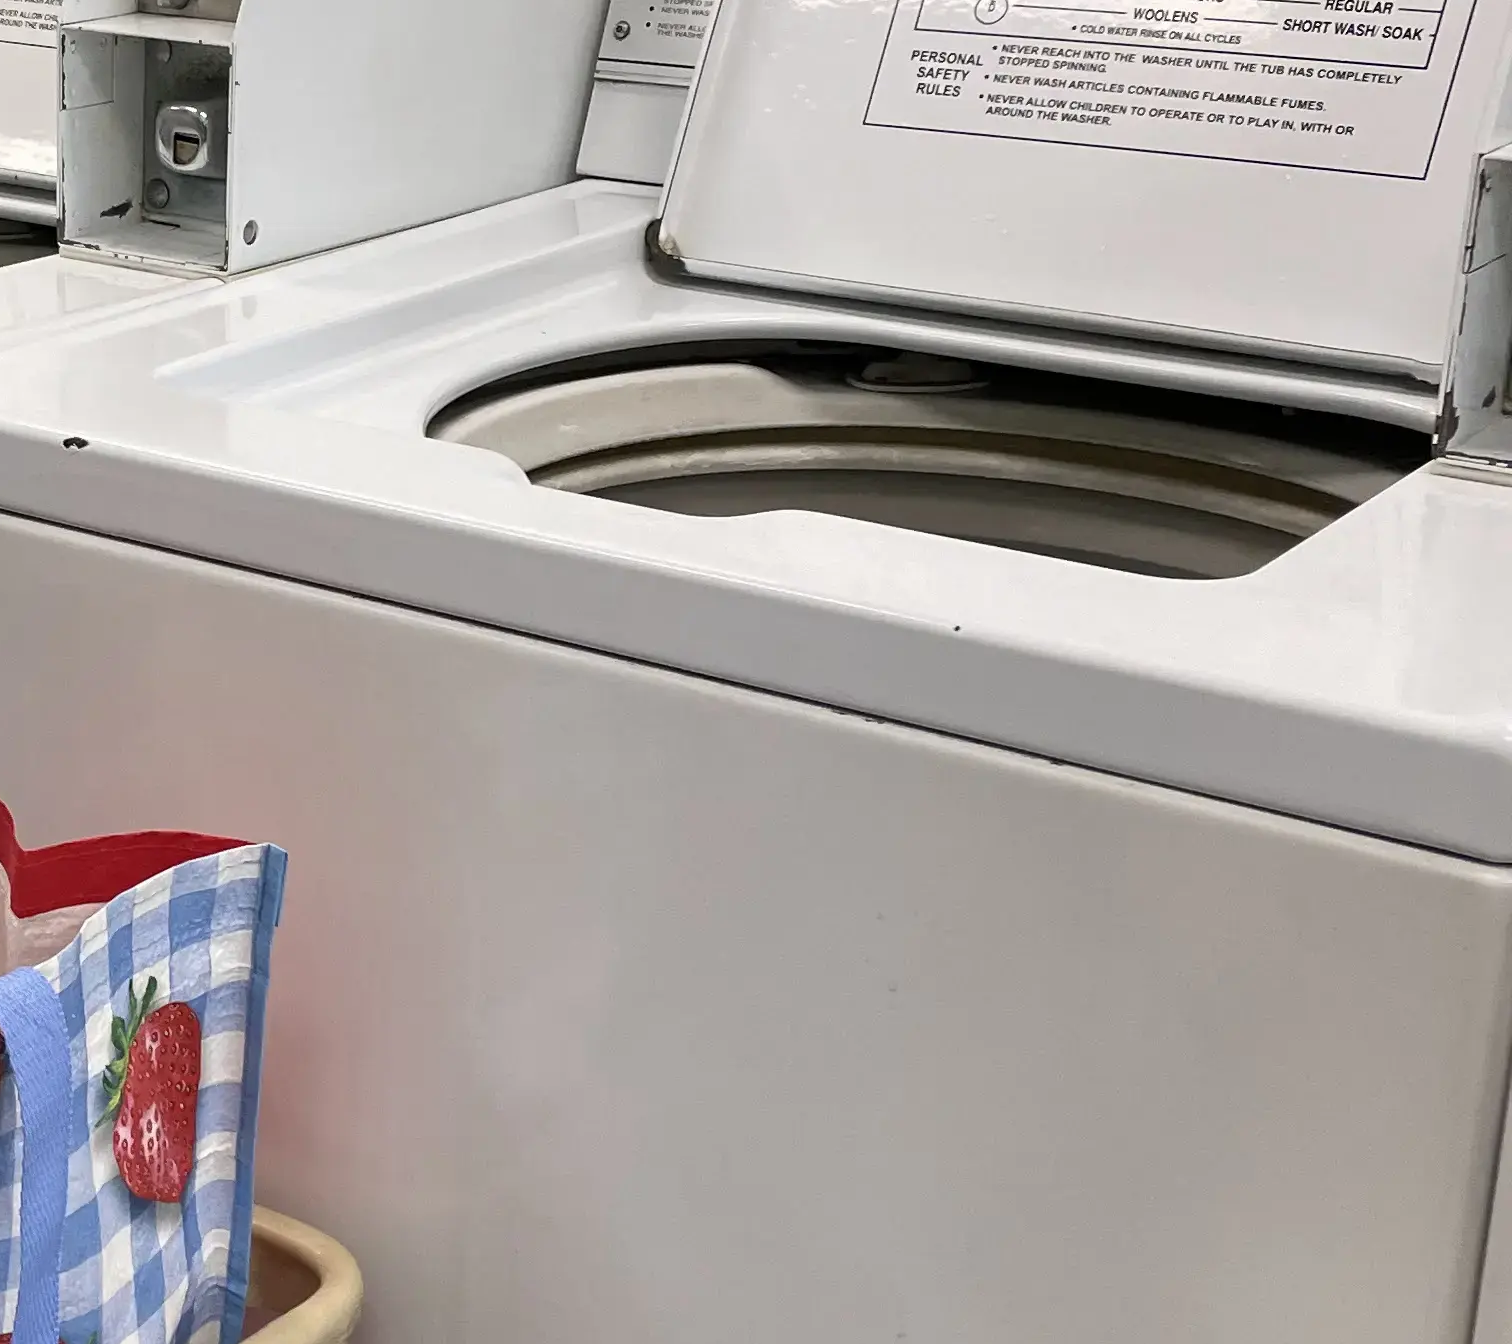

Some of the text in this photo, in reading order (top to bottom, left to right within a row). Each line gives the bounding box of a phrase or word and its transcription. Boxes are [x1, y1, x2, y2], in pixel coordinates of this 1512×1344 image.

[1133, 8, 1199, 24] WOOLENS
[1080, 25, 1242, 45] COLD WATER RINSE ON ALL CYCLES
[1282, 19, 1332, 34] SHORT
[1382, 26, 1424, 41] SOAK
[910, 49, 984, 67] PERSONAL
[998, 56, 1051, 69] STOPPED
[1001, 44, 1403, 85] NEVER REACH INTO THE WASHER UNTIL THE TUB HAS COMPLETELY
[916, 66, 970, 82] SAFETY
[915, 83, 961, 98] RULES
[993, 74, 1327, 112] NEVER WASH ARTICLES CONTAINING FLAMMABLE FUMES.
[986, 106, 1034, 119] AROUND
[1037, 109, 1058, 121] THE
[987, 93, 1024, 106] NEVER
[1025, 97, 1068, 109] ALLOW
[1069, 100, 1127, 115] CHILDREN
[1131, 106, 1146, 117] TO
[1148, 108, 1204, 122] OPERATE
[1207, 113, 1225, 124] OR
[1228, 115, 1245, 126] TO
[1247, 116, 1280, 129] PLAY
[1300, 121, 1333, 134] WITH
[1335, 125, 1355, 136] OR
